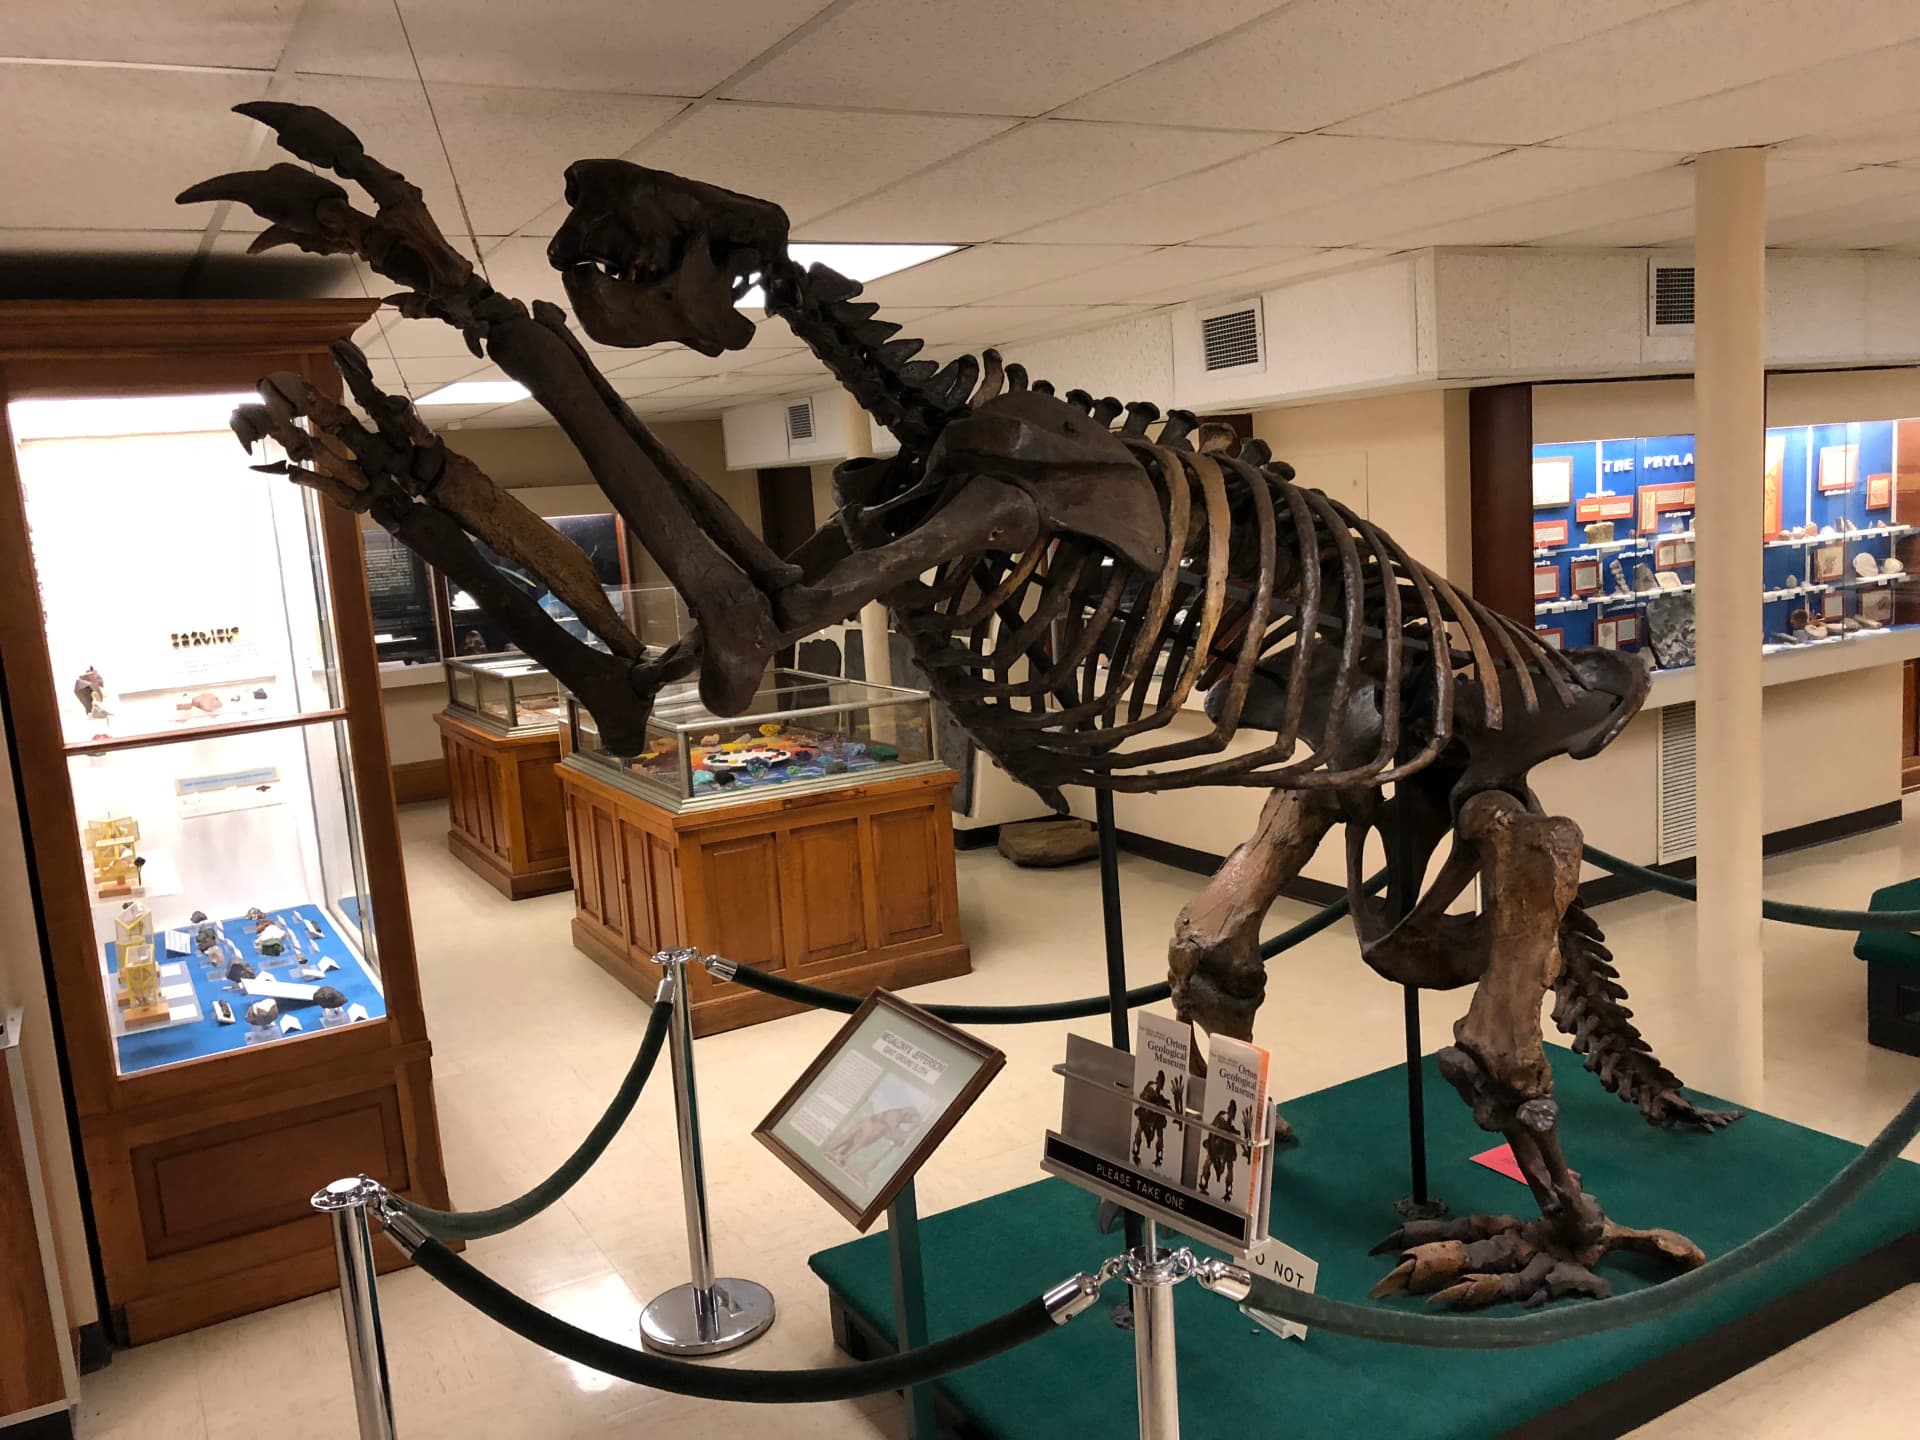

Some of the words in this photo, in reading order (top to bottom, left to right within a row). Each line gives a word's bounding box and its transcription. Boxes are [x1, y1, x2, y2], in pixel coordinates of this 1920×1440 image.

[1602, 458, 1634, 472] THE
[1644, 454, 1693, 468] PHYLA
[1147, 1040, 1187, 1061] Geological
[1165, 1036, 1187, 1051] Orton
[1154, 1052, 1186, 1072] Museum
[1238, 1064, 1258, 1080] Orton
[1219, 1068, 1257, 1090] Geological
[1226, 1080, 1256, 1100] Museum
[1096, 1163, 1132, 1188] PLEASE
[1136, 1182, 1161, 1200] TAKE
[1165, 1192, 1185, 1210] ONE
[1274, 1260, 1304, 1289] NOT
